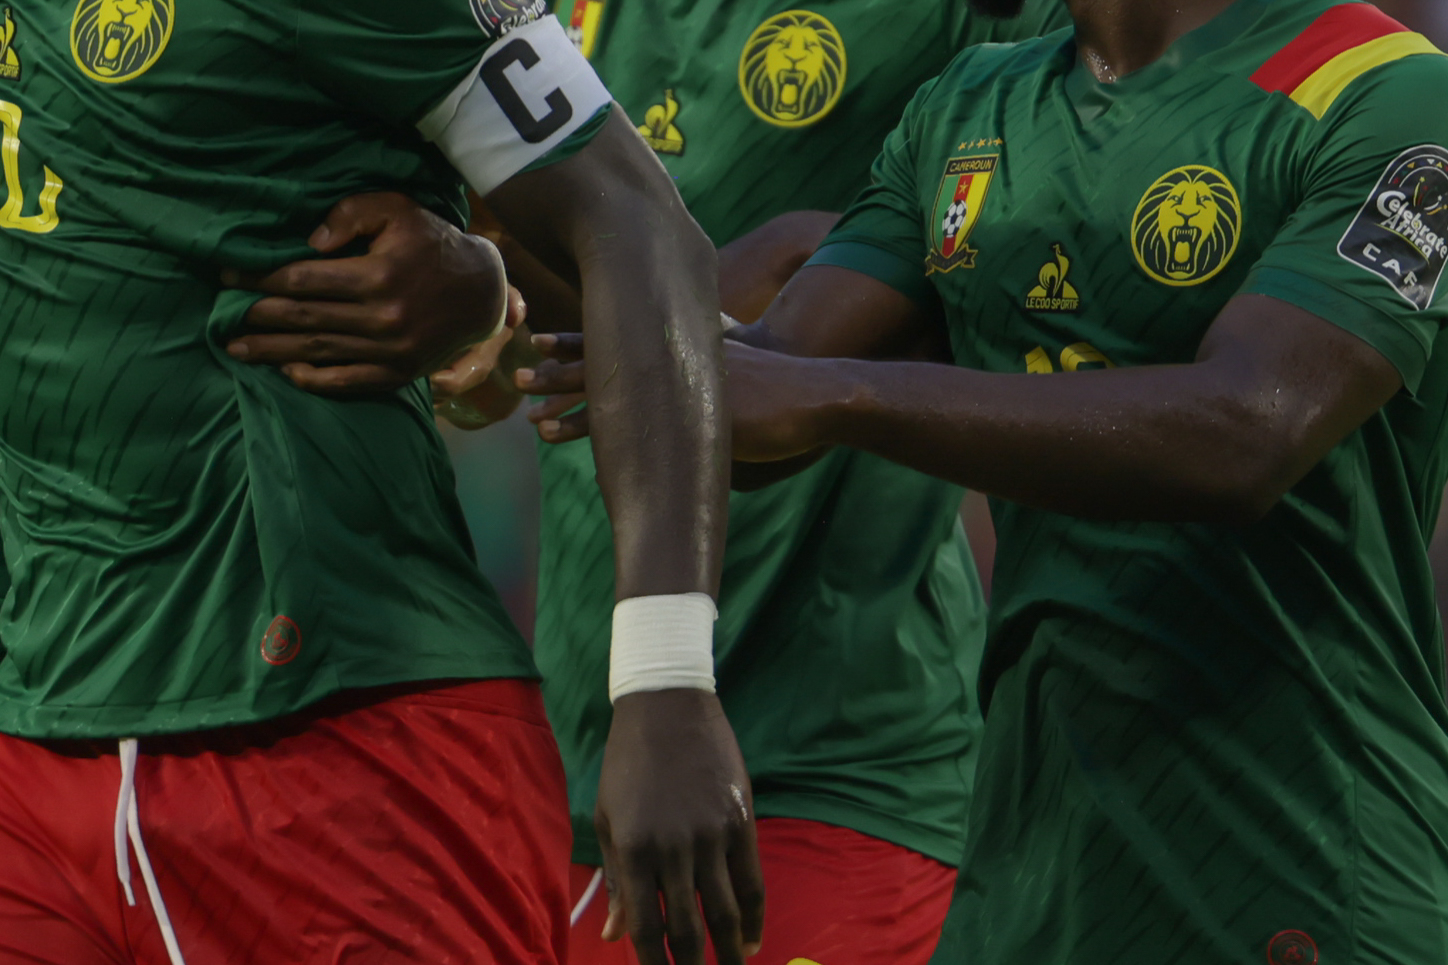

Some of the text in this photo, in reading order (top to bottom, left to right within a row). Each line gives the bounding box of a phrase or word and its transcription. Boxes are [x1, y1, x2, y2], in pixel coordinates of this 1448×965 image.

[479, 38, 573, 144] C
[949, 159, 993, 172] CAMEROUN
[1376, 190, 1448, 259] Celebrate
[1380, 213, 1433, 259] Africa
[1362, 242, 1418, 287] CAF
[1050, 297, 1079, 311] SPORTIF
